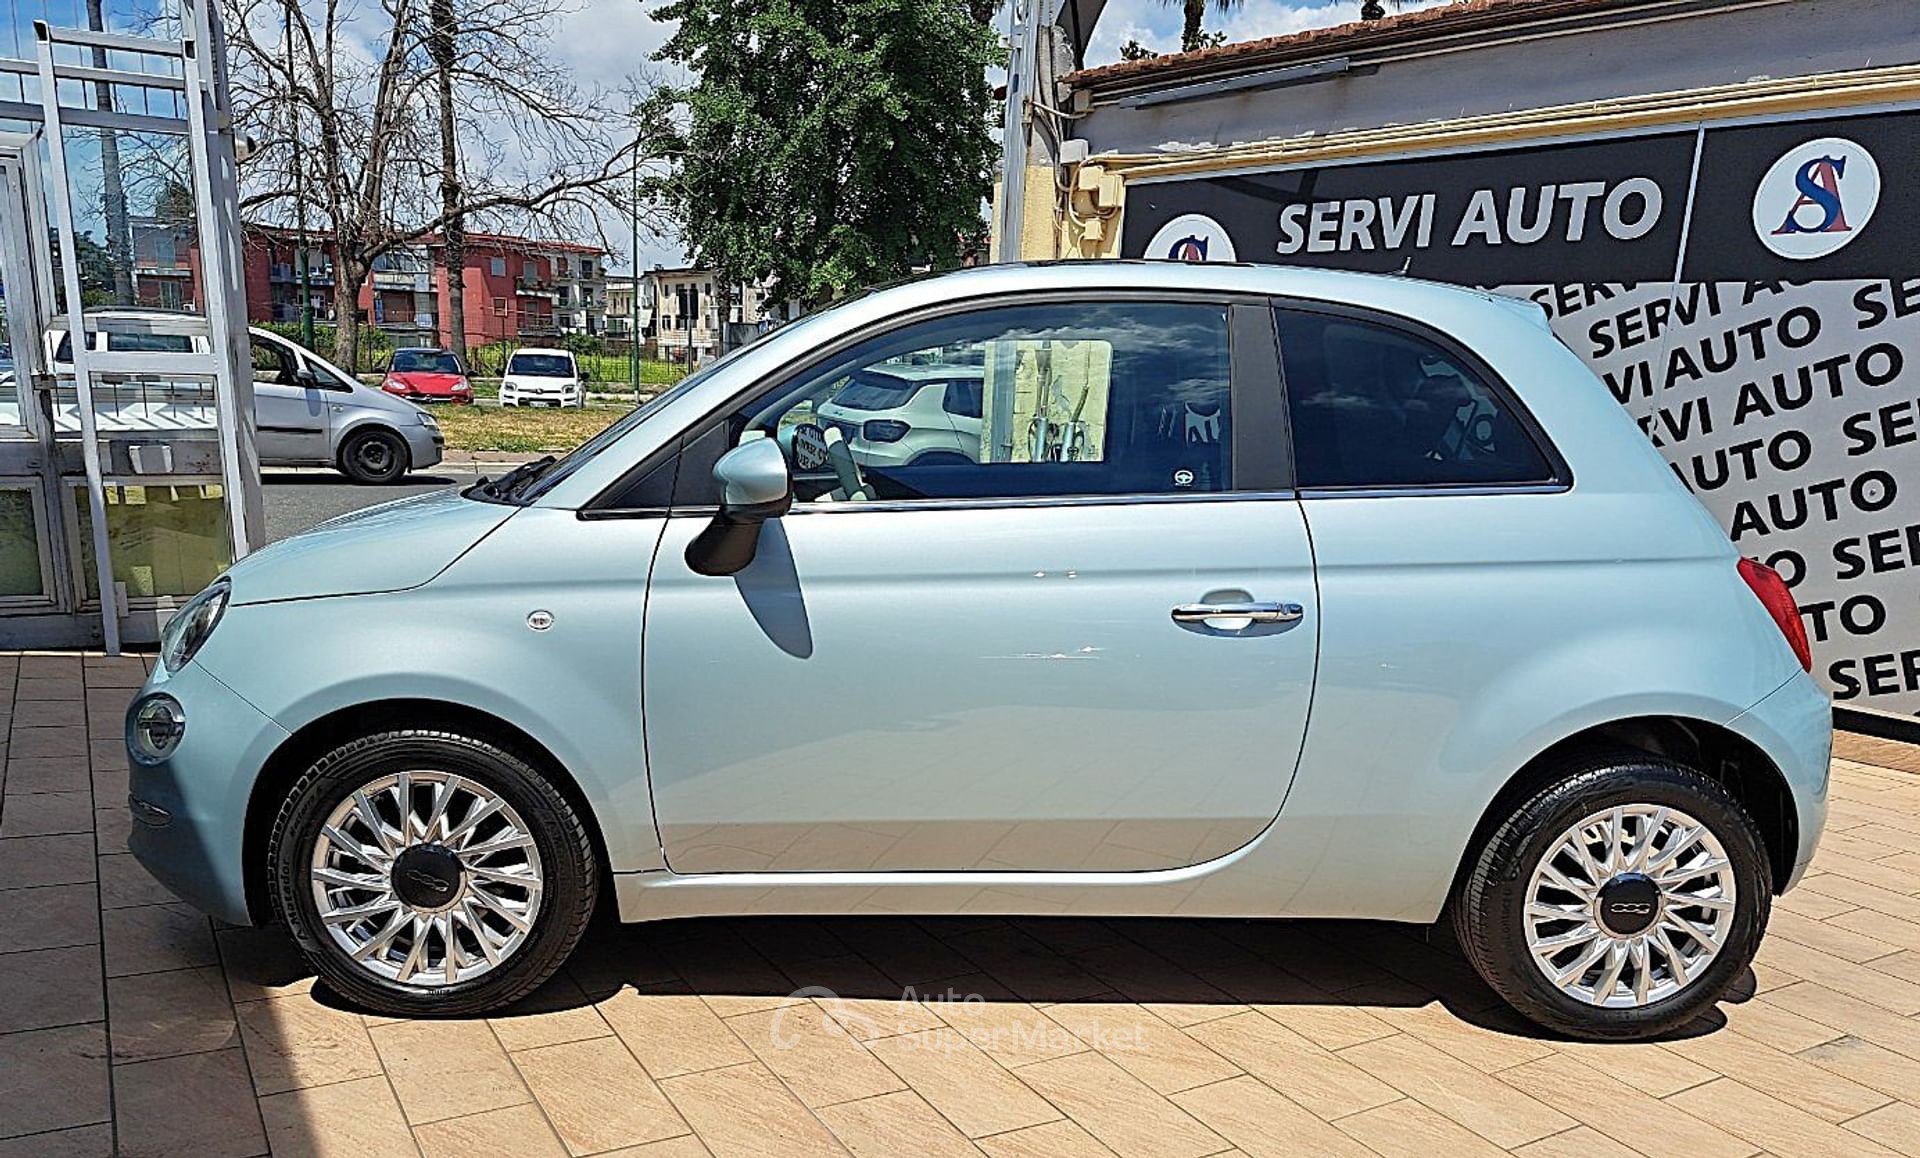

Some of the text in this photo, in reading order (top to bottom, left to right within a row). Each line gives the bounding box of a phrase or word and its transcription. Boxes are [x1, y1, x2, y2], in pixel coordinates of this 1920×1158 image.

[1276, 193, 1435, 255] SERVI
[1452, 177, 1663, 247] AUTO
[1588, 281, 1721, 359] SERVI
[1664, 306, 1822, 389] AUTO
[1733, 342, 1903, 426] AUTO
[1730, 470, 1898, 542] AUTO
